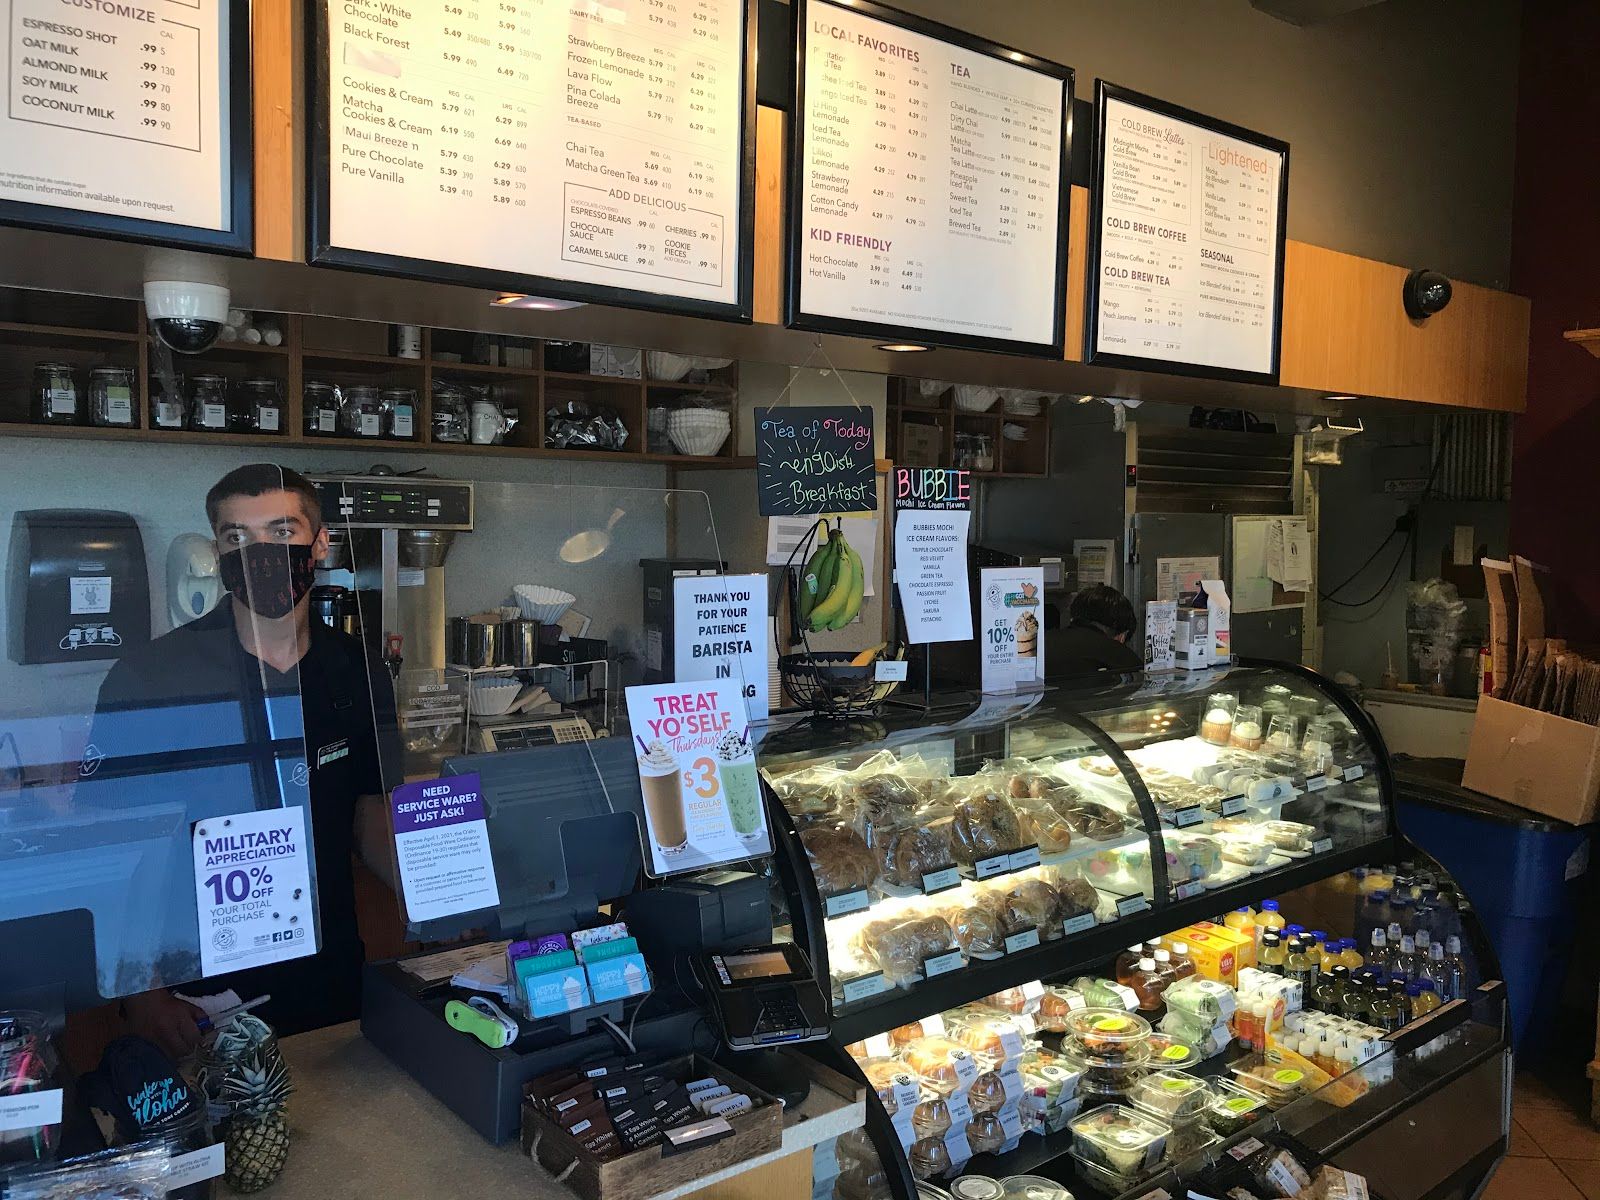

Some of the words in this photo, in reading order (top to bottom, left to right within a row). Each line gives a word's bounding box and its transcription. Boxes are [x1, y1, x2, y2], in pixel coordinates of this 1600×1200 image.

[344, 4, 399, 28] Chocolate
[22, 17, 83, 38] ESPRESSO
[86, 30, 117, 45] SHOT
[160, 30, 175, 39] CAL
[344, 23, 373, 40] Black
[376, 33, 410, 50] Forest
[22, 37, 47, 49] OAT
[50, 43, 79, 56] MILK
[568, 34, 615, 57] Strawberry
[616, 48, 646, 64] Breeze
[858, 34, 920, 63] FAVORITES
[22, 57, 77, 74] ALMOND
[80, 67, 108, 80] MILK
[951, 63, 971, 79] TEA
[22, 76, 47, 88] SOY
[50, 81, 79, 94] MILK
[343, 77, 386, 96] Cookies
[388, 88, 397, 98] &
[399, 91, 433, 107] Cream
[22, 95, 84, 114] COCONUT
[87, 106, 115, 119] MILK
[343, 94, 383, 113] Matcha
[567, 95, 599, 110] Breeze
[343, 107, 386, 126] Cookies
[388, 118, 396, 128] &
[399, 120, 433, 135] Cream
[1121, 118, 1141, 131] COLD
[1143, 125, 1162, 138] BREW
[566, 141, 587, 154] Chai
[589, 146, 605, 158] Tea
[950, 135, 971, 147] Matcha
[342, 144, 366, 158] Pure
[369, 151, 424, 169] Chocolate
[1208, 142, 1268, 174] Lightened
[342, 163, 366, 176] Pure
[369, 168, 405, 184] Vanilla
[565, 158, 598, 173] Matcha
[600, 165, 625, 179] Green
[626, 171, 640, 183] Tea
[811, 171, 850, 186] Strawberry
[811, 180, 849, 194] Lemonade
[35, 183, 83, 199] information
[84, 193, 121, 204] available
[122, 198, 141, 208] upon
[143, 201, 175, 212] request.
[608, 188, 631, 200] ADD
[633, 194, 687, 212] DELICIOUS
[811, 194, 834, 206] Cotton
[836, 199, 859, 212] Candy
[810, 204, 848, 218] Lemonade
[1106, 217, 1131, 230] COLD
[1133, 222, 1156, 235] BREW
[1157, 229, 1187, 243] COFFEE
[811, 228, 832, 242] KID
[836, 232, 892, 252] FRIENDLY
[809, 253, 822, 263] Hot
[823, 255, 859, 268] Chocolate
[1105, 250, 1116, 258] Cold
[1117, 253, 1128, 261] Brew
[1129, 255, 1144, 263] Coffee
[1200, 248, 1234, 265] SEASONAL
[809, 268, 822, 277] Hot
[823, 271, 846, 281] Vanilla
[1104, 266, 1129, 279] COLD
[1131, 271, 1154, 284] BREW
[1155, 275, 1170, 286] TEA
[762, 419, 795, 438] Tea
[802, 420, 819, 440] of
[824, 419, 871, 450] Today
[789, 480, 868, 504] Breakfast
[897, 469, 971, 502] BUBBIE
[896, 498, 915, 508] Mochi
[917, 500, 927, 509] Ice
[928, 501, 945, 510] Cream
[694, 593, 728, 604] THANK
[730, 592, 750, 601] YOU
[697, 610, 717, 620] FOR
[721, 608, 747, 618] YOUR
[699, 624, 746, 636] PATIENCE
[987, 627, 1015, 644] 10%
[692, 640, 752, 658] BARISTA
[715, 665, 731, 678] IN
[654, 692, 718, 716] TREAT
[648, 712, 731, 738] YO'SELF
[422, 785, 450, 798] NEED
[397, 799, 440, 814] SERVICE
[442, 792, 477, 807] WARE?
[689, 800, 721, 810] REGULAR
[414, 811, 438, 824] JUST
[440, 807, 464, 819] ASK!
[205, 827, 293, 855] MILITARY
[205, 844, 295, 867] APPRECIATION
[204, 866, 273, 906] 10%
[252, 887, 274, 899] OFF
[210, 904, 239, 917] YOUR
[241, 900, 272, 912] TOTAL
[212, 910, 265, 927] PURCHASE
[720, 1101, 743, 1114] SIMPLY
